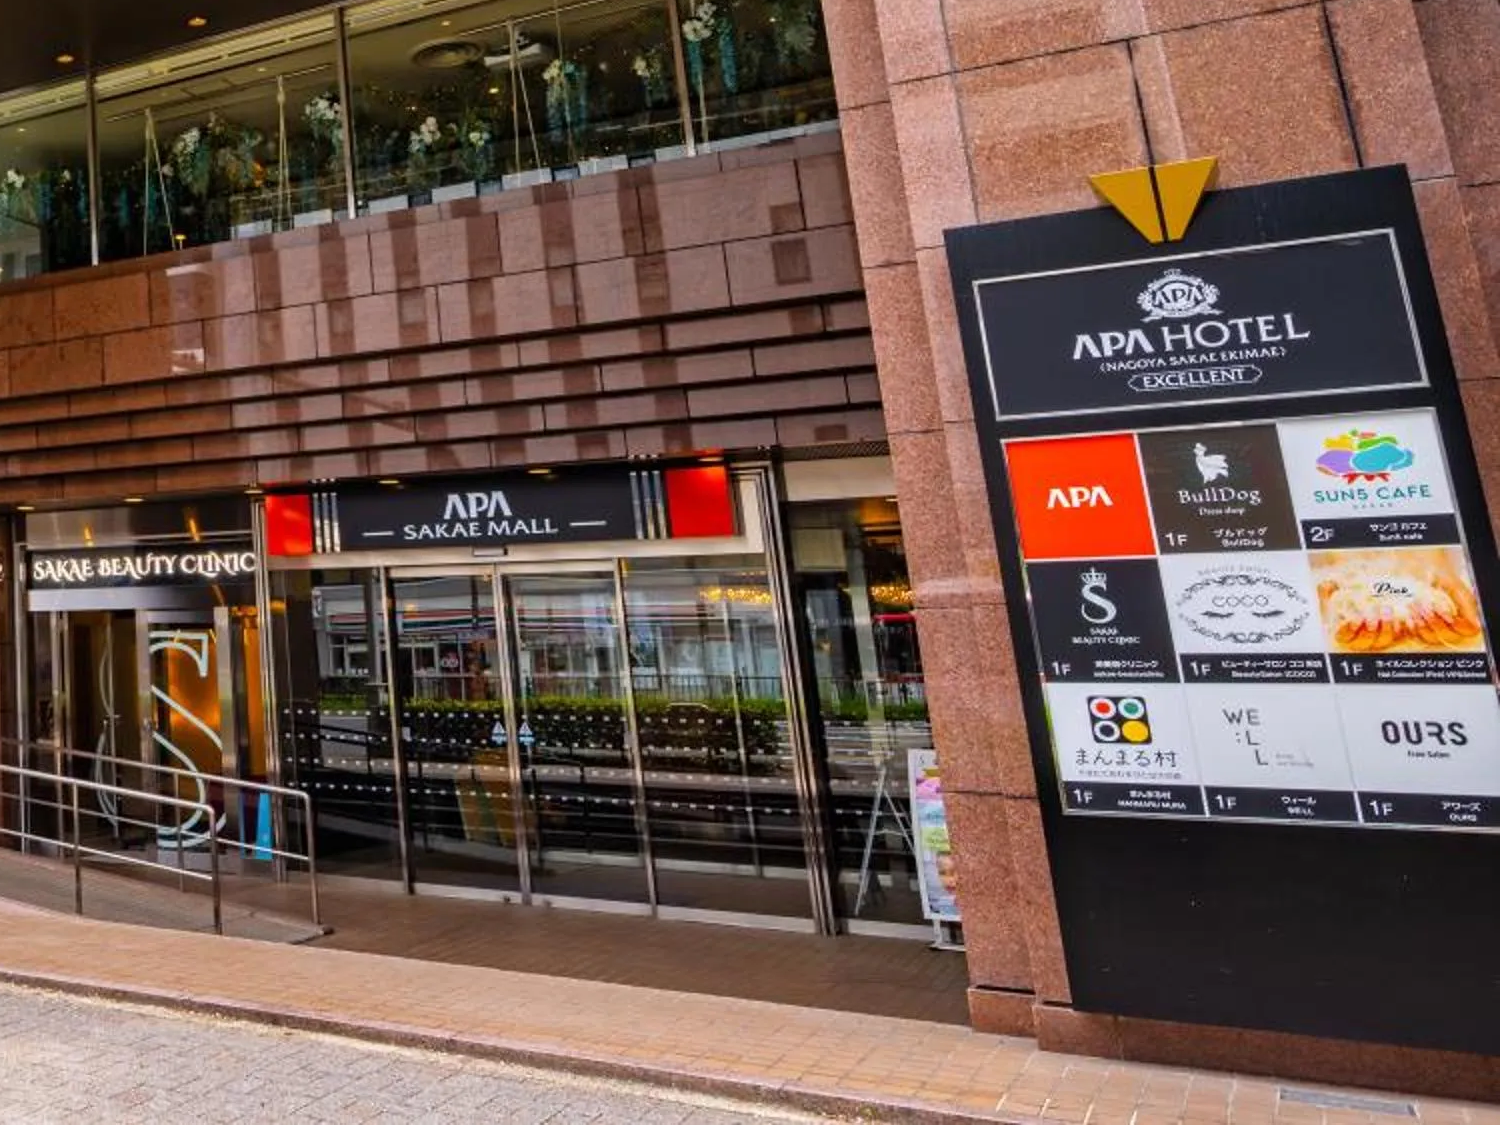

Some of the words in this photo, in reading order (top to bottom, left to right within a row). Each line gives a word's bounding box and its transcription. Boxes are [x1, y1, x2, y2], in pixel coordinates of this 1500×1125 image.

[1073, 329, 1154, 360] APA
[1161, 312, 1311, 352] HOTEL
[1169, 352, 1219, 367] SAKAE
[1142, 368, 1246, 388] EXCELLENT
[1047, 485, 1113, 510] APA
[1178, 487, 1262, 507] BullDog
[1313, 488, 1370, 505] SUN5
[1375, 484, 1433, 501] CAFE
[443, 490, 513, 520] APA
[403, 523, 483, 540] SAKAE
[487, 517, 560, 536] MALL
[1310, 526, 1336, 543] 2F
[1164, 531, 1188, 548] 1F
[33, 560, 95, 582] SAKAE
[98, 553, 179, 579] BEAUTY
[180, 552, 258, 578] CLINIC
[1081, 581, 1117, 624] S
[1052, 660, 1072, 676] 1F
[1190, 661, 1211, 676] 1F
[1340, 660, 1363, 676] 1F
[1222, 708, 1260, 726] WE
[1381, 720, 1468, 746] OURS
[1075, 748, 1181, 768] まんまる村
[1073, 788, 1093, 805] 1F
[1215, 794, 1237, 810] 1F
[1369, 800, 1393, 816] 1F
